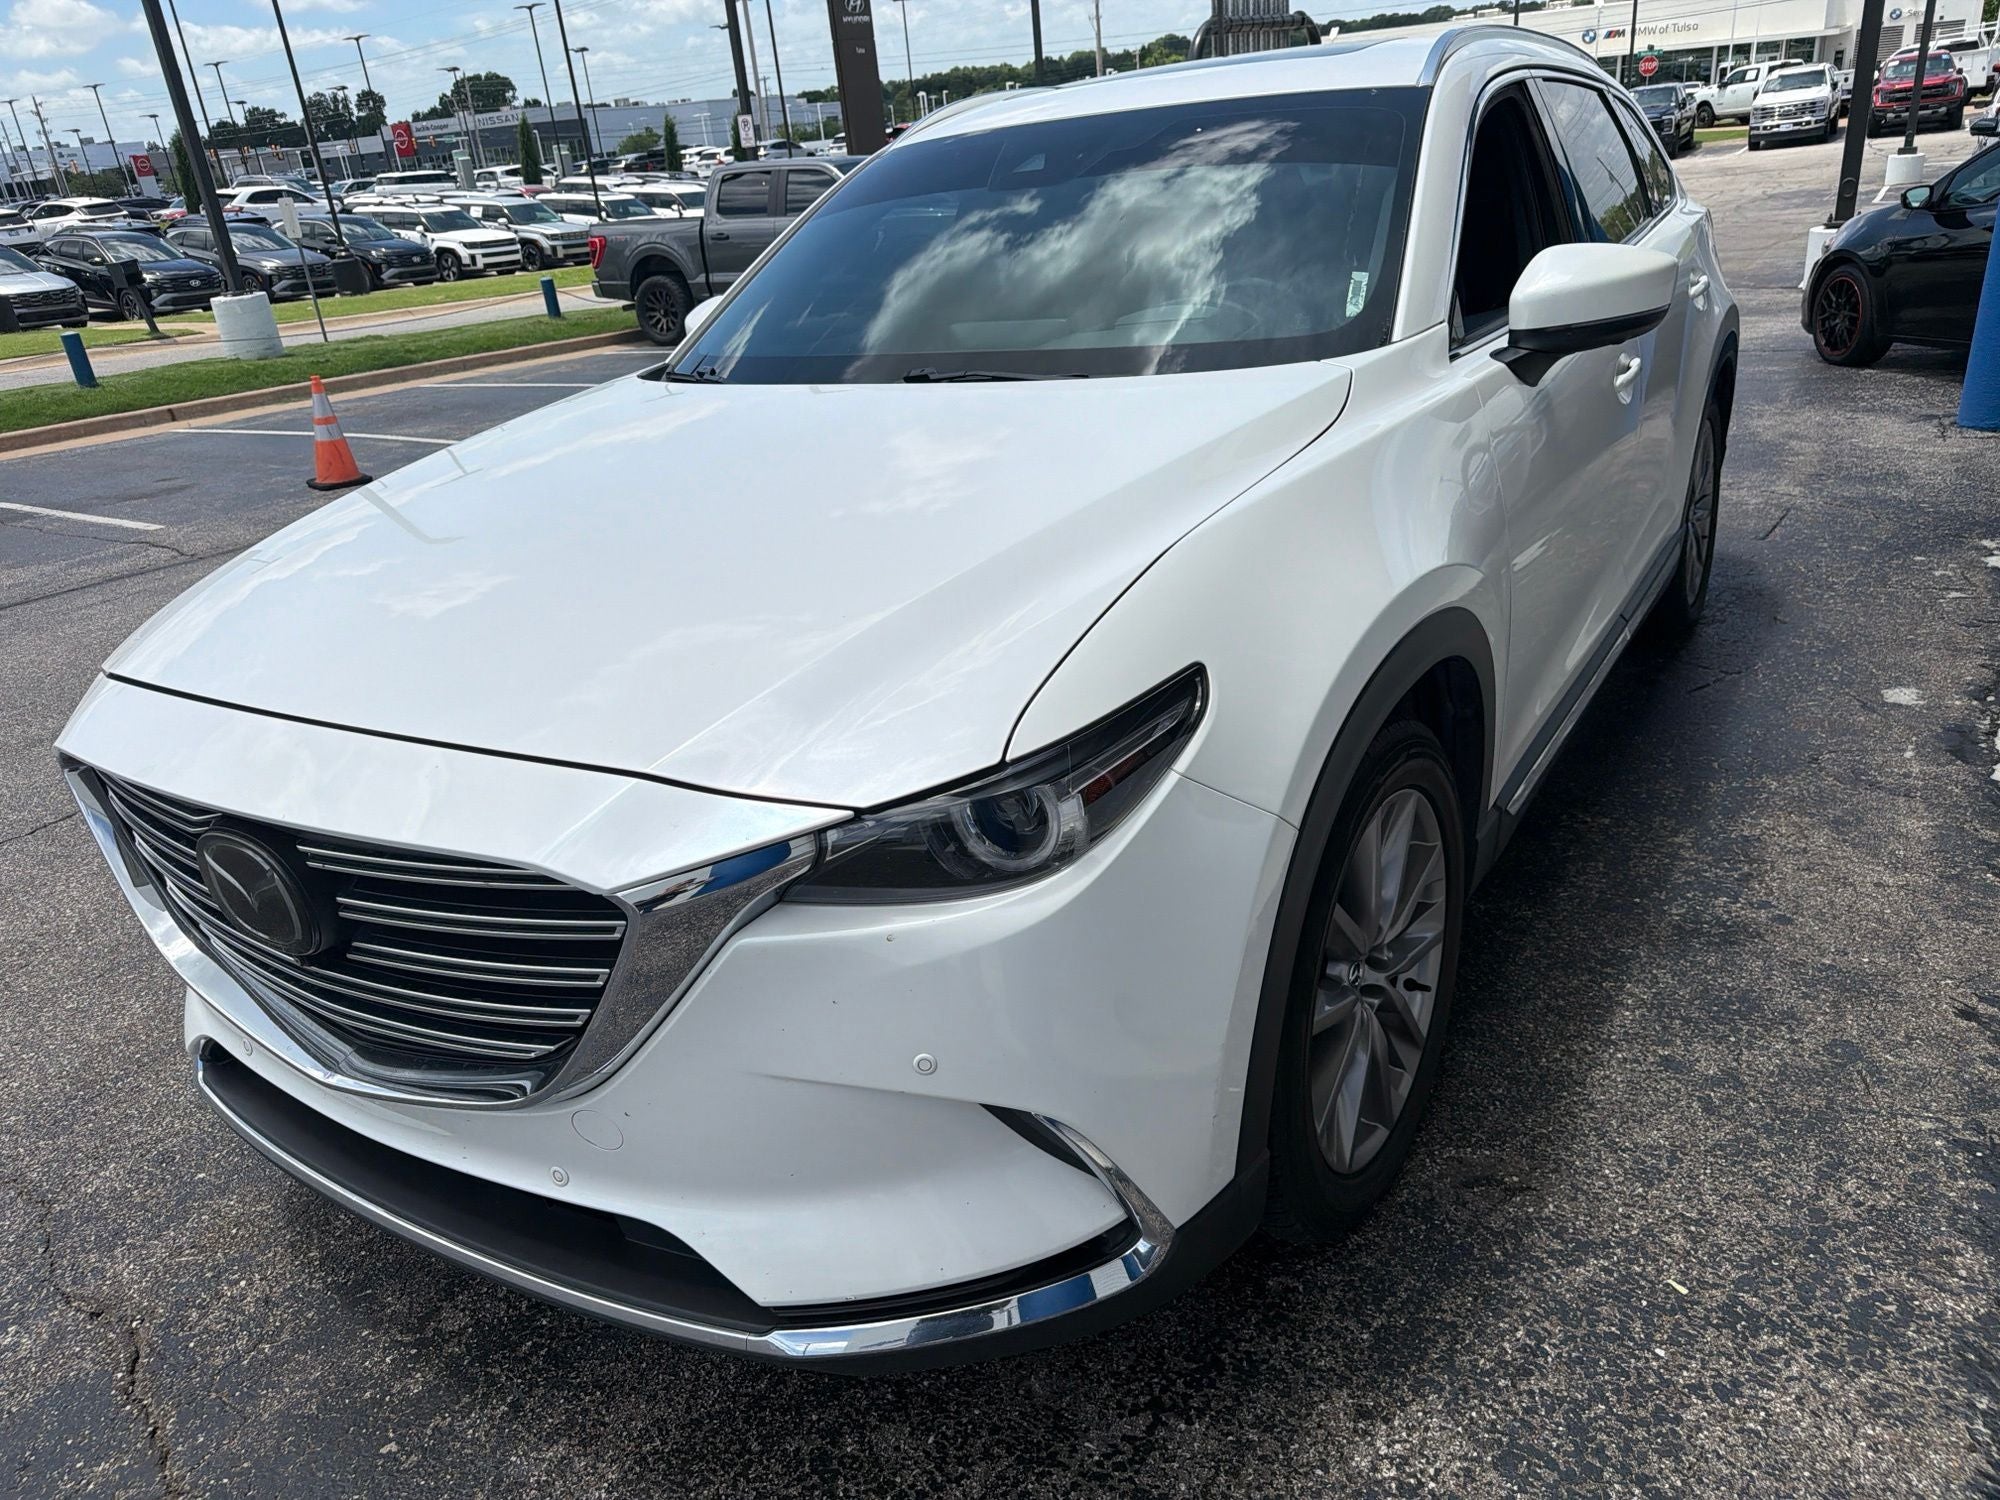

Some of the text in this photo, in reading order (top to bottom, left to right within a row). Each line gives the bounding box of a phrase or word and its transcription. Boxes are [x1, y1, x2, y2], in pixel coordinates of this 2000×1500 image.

[1658, 23, 1669, 34] of
[1641, 61, 1657, 71] STOP
[477, 112, 519, 127] NISSAN
